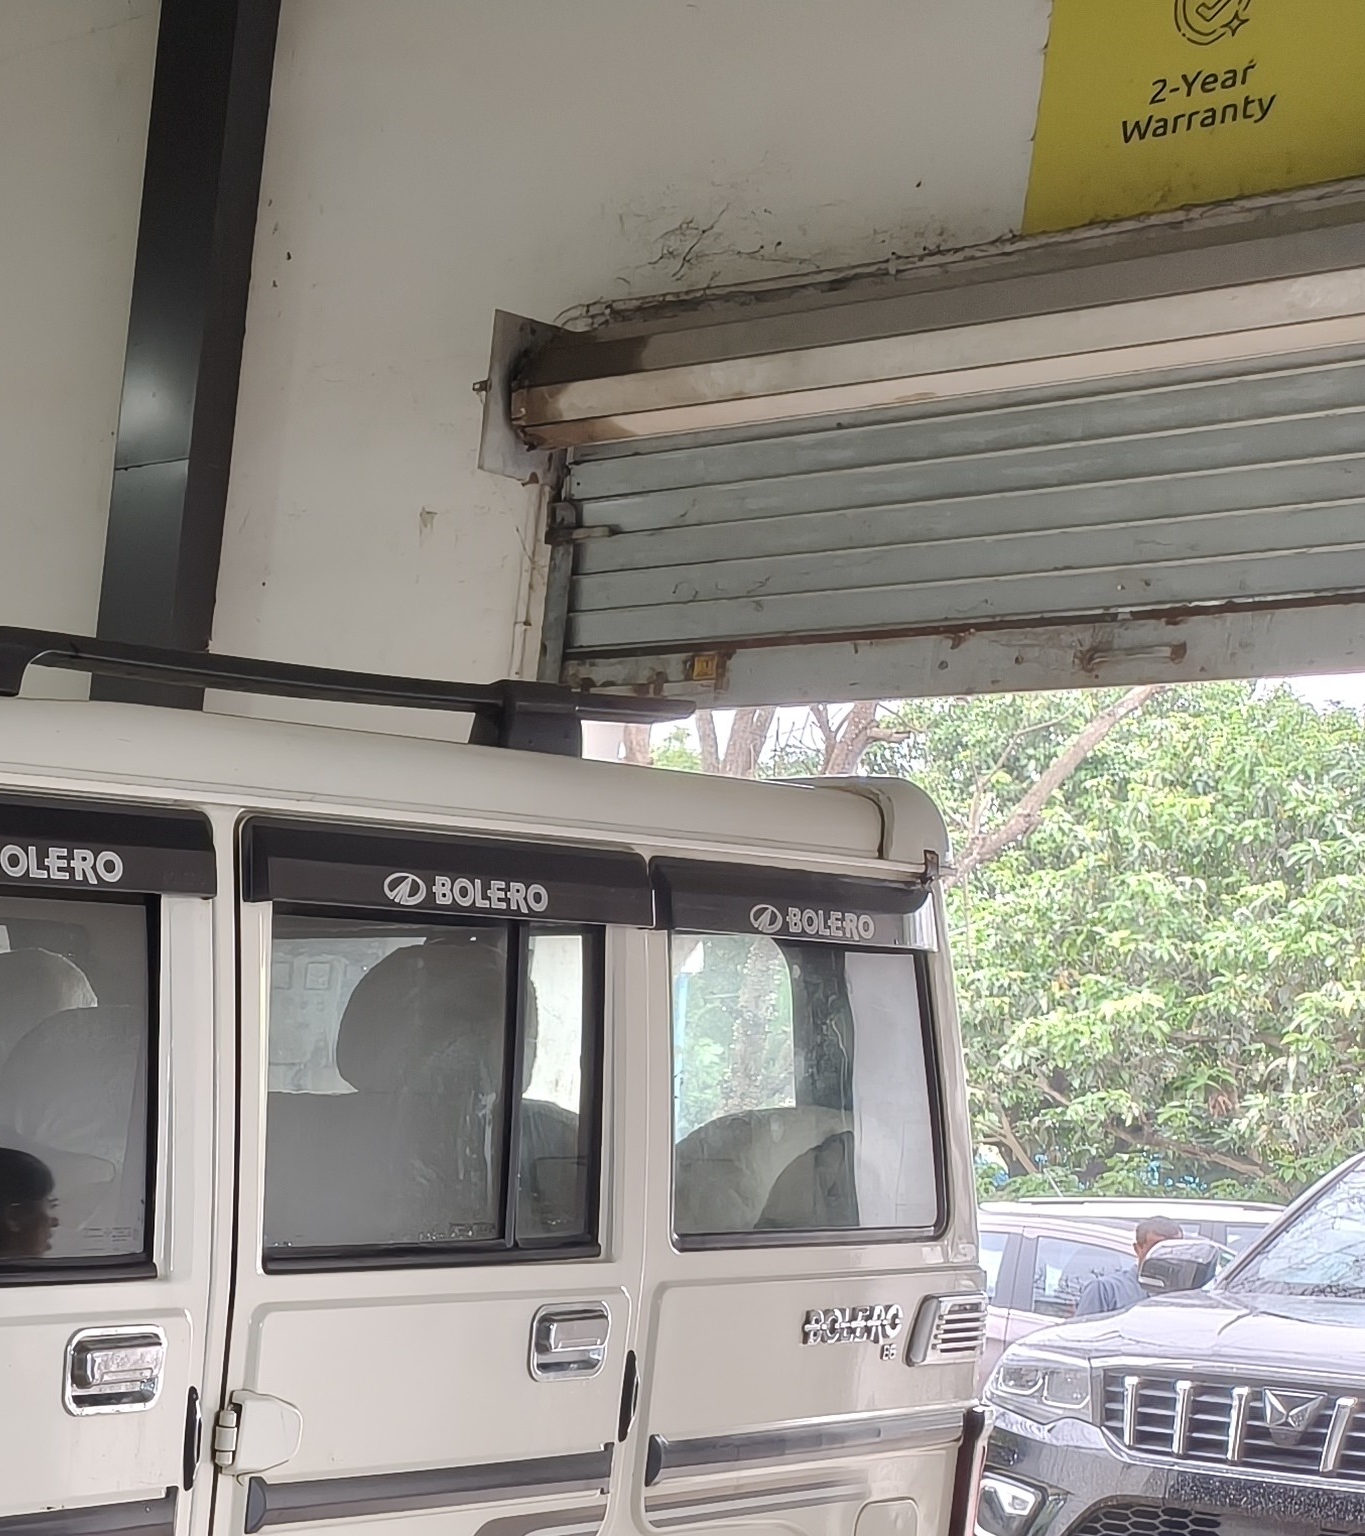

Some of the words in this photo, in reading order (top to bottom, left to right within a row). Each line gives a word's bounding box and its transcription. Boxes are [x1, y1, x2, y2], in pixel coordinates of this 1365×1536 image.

[1148, 59, 1258, 106] 2-Year
[1121, 94, 1277, 143] Warranty
[432, 875, 549, 915] BOLERO
[786, 906, 876, 941] BOLERO
[801, 1303, 904, 1345] BOLERO
